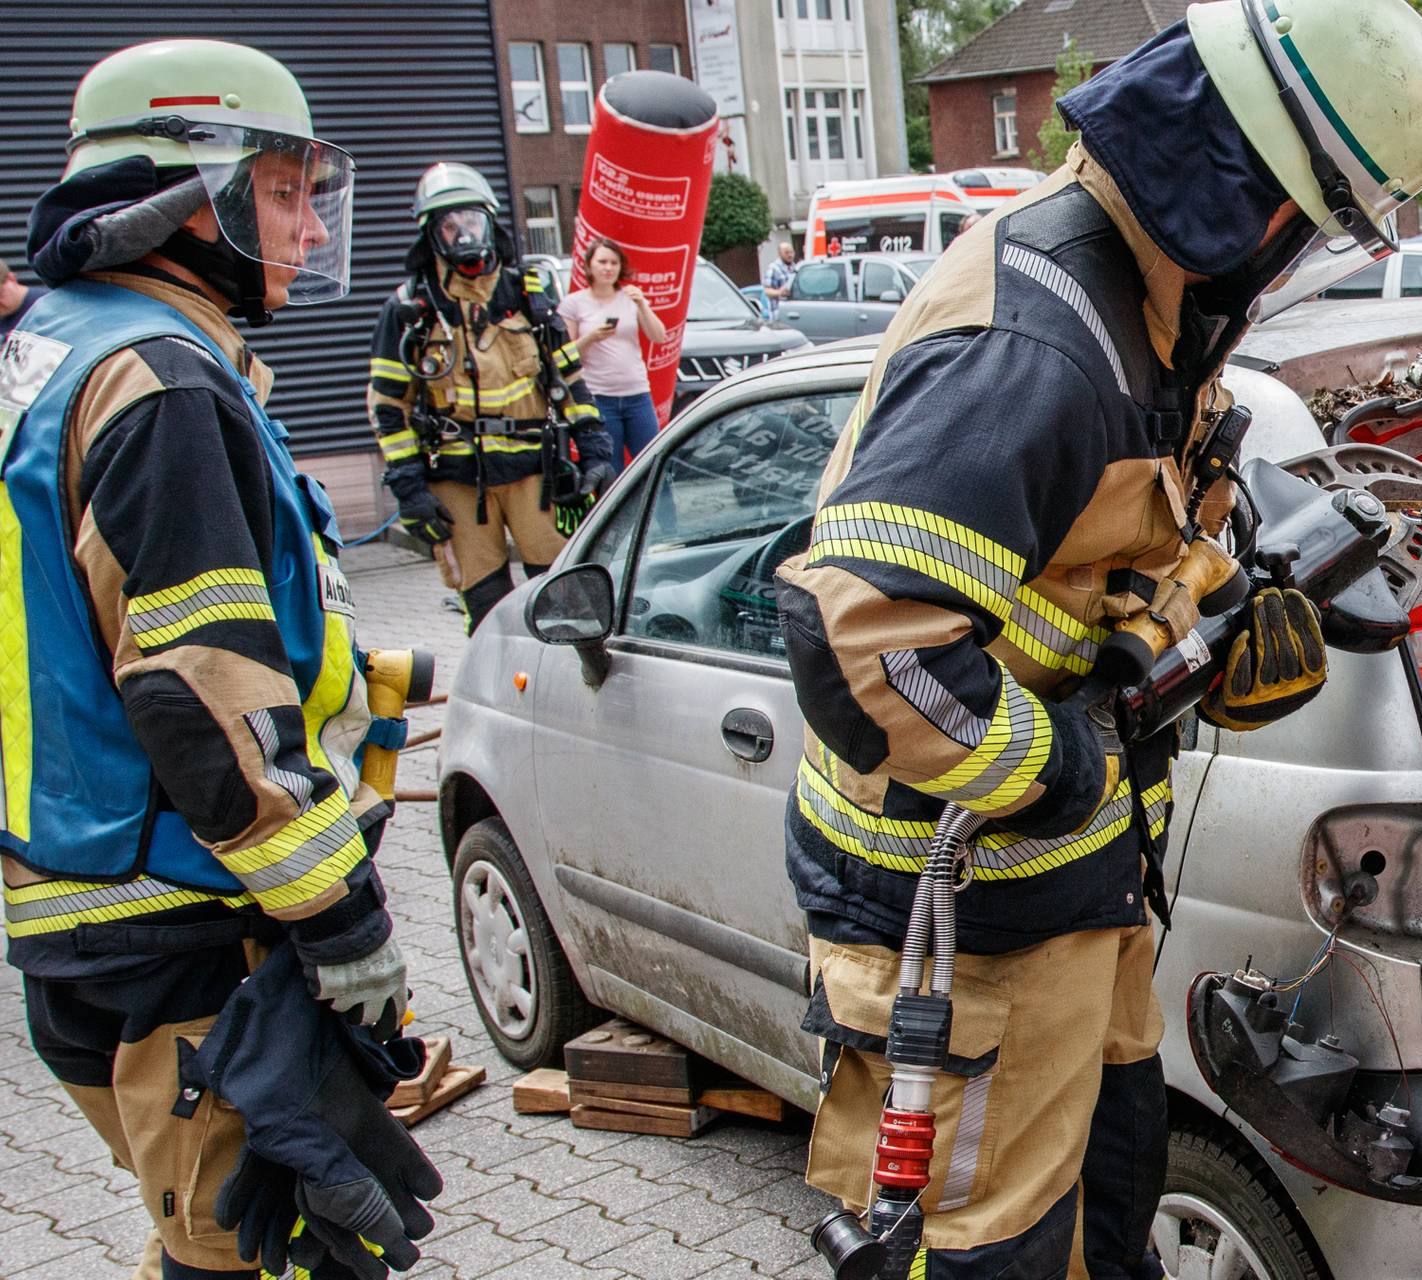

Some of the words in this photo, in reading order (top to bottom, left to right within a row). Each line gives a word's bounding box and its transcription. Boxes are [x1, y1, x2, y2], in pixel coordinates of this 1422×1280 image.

[600, 176, 635, 195] radio
[635, 192, 681, 203] essen
[892, 235, 913, 253] 112
[632, 271, 677, 284] sen
